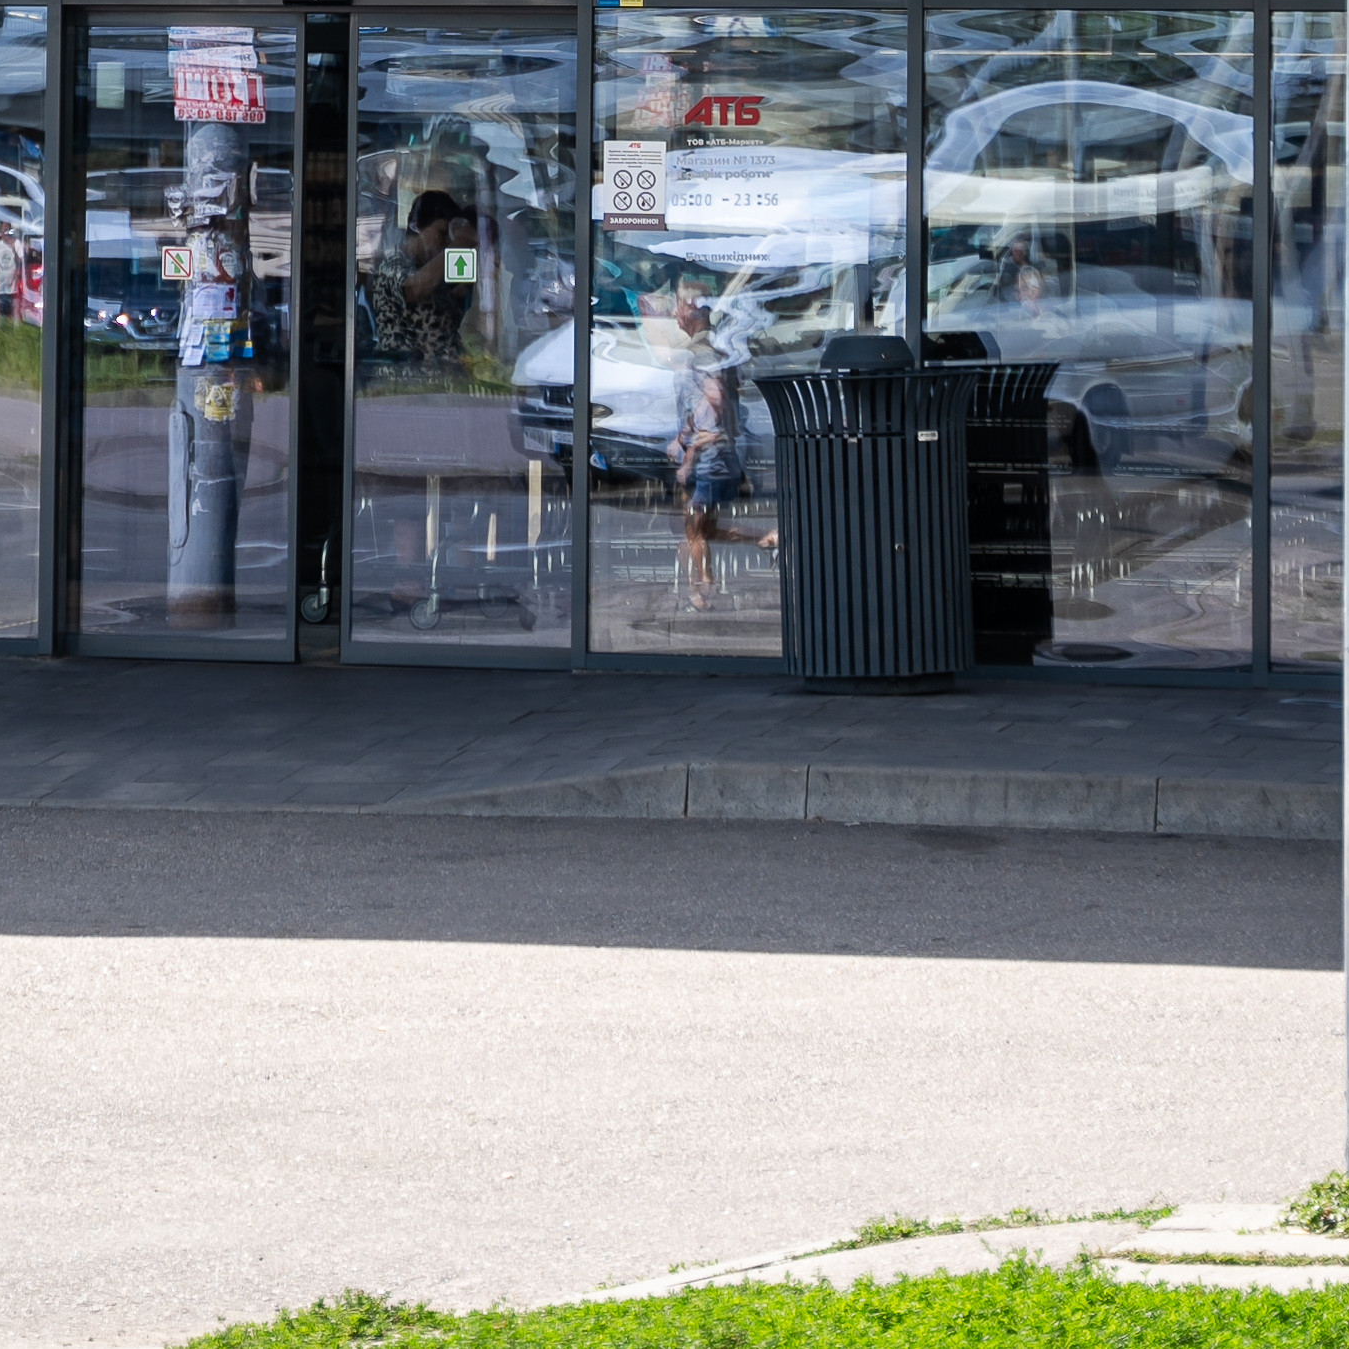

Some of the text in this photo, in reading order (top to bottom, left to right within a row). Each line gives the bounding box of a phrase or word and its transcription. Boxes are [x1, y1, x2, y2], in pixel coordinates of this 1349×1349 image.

[684, 96, 765, 126] АТБ
[686, 138, 704, 147] ТОВ
[676, 155, 730, 165] Магазин
[750, 155, 776, 165] 1373
[671, 193, 713, 207] 05:00
